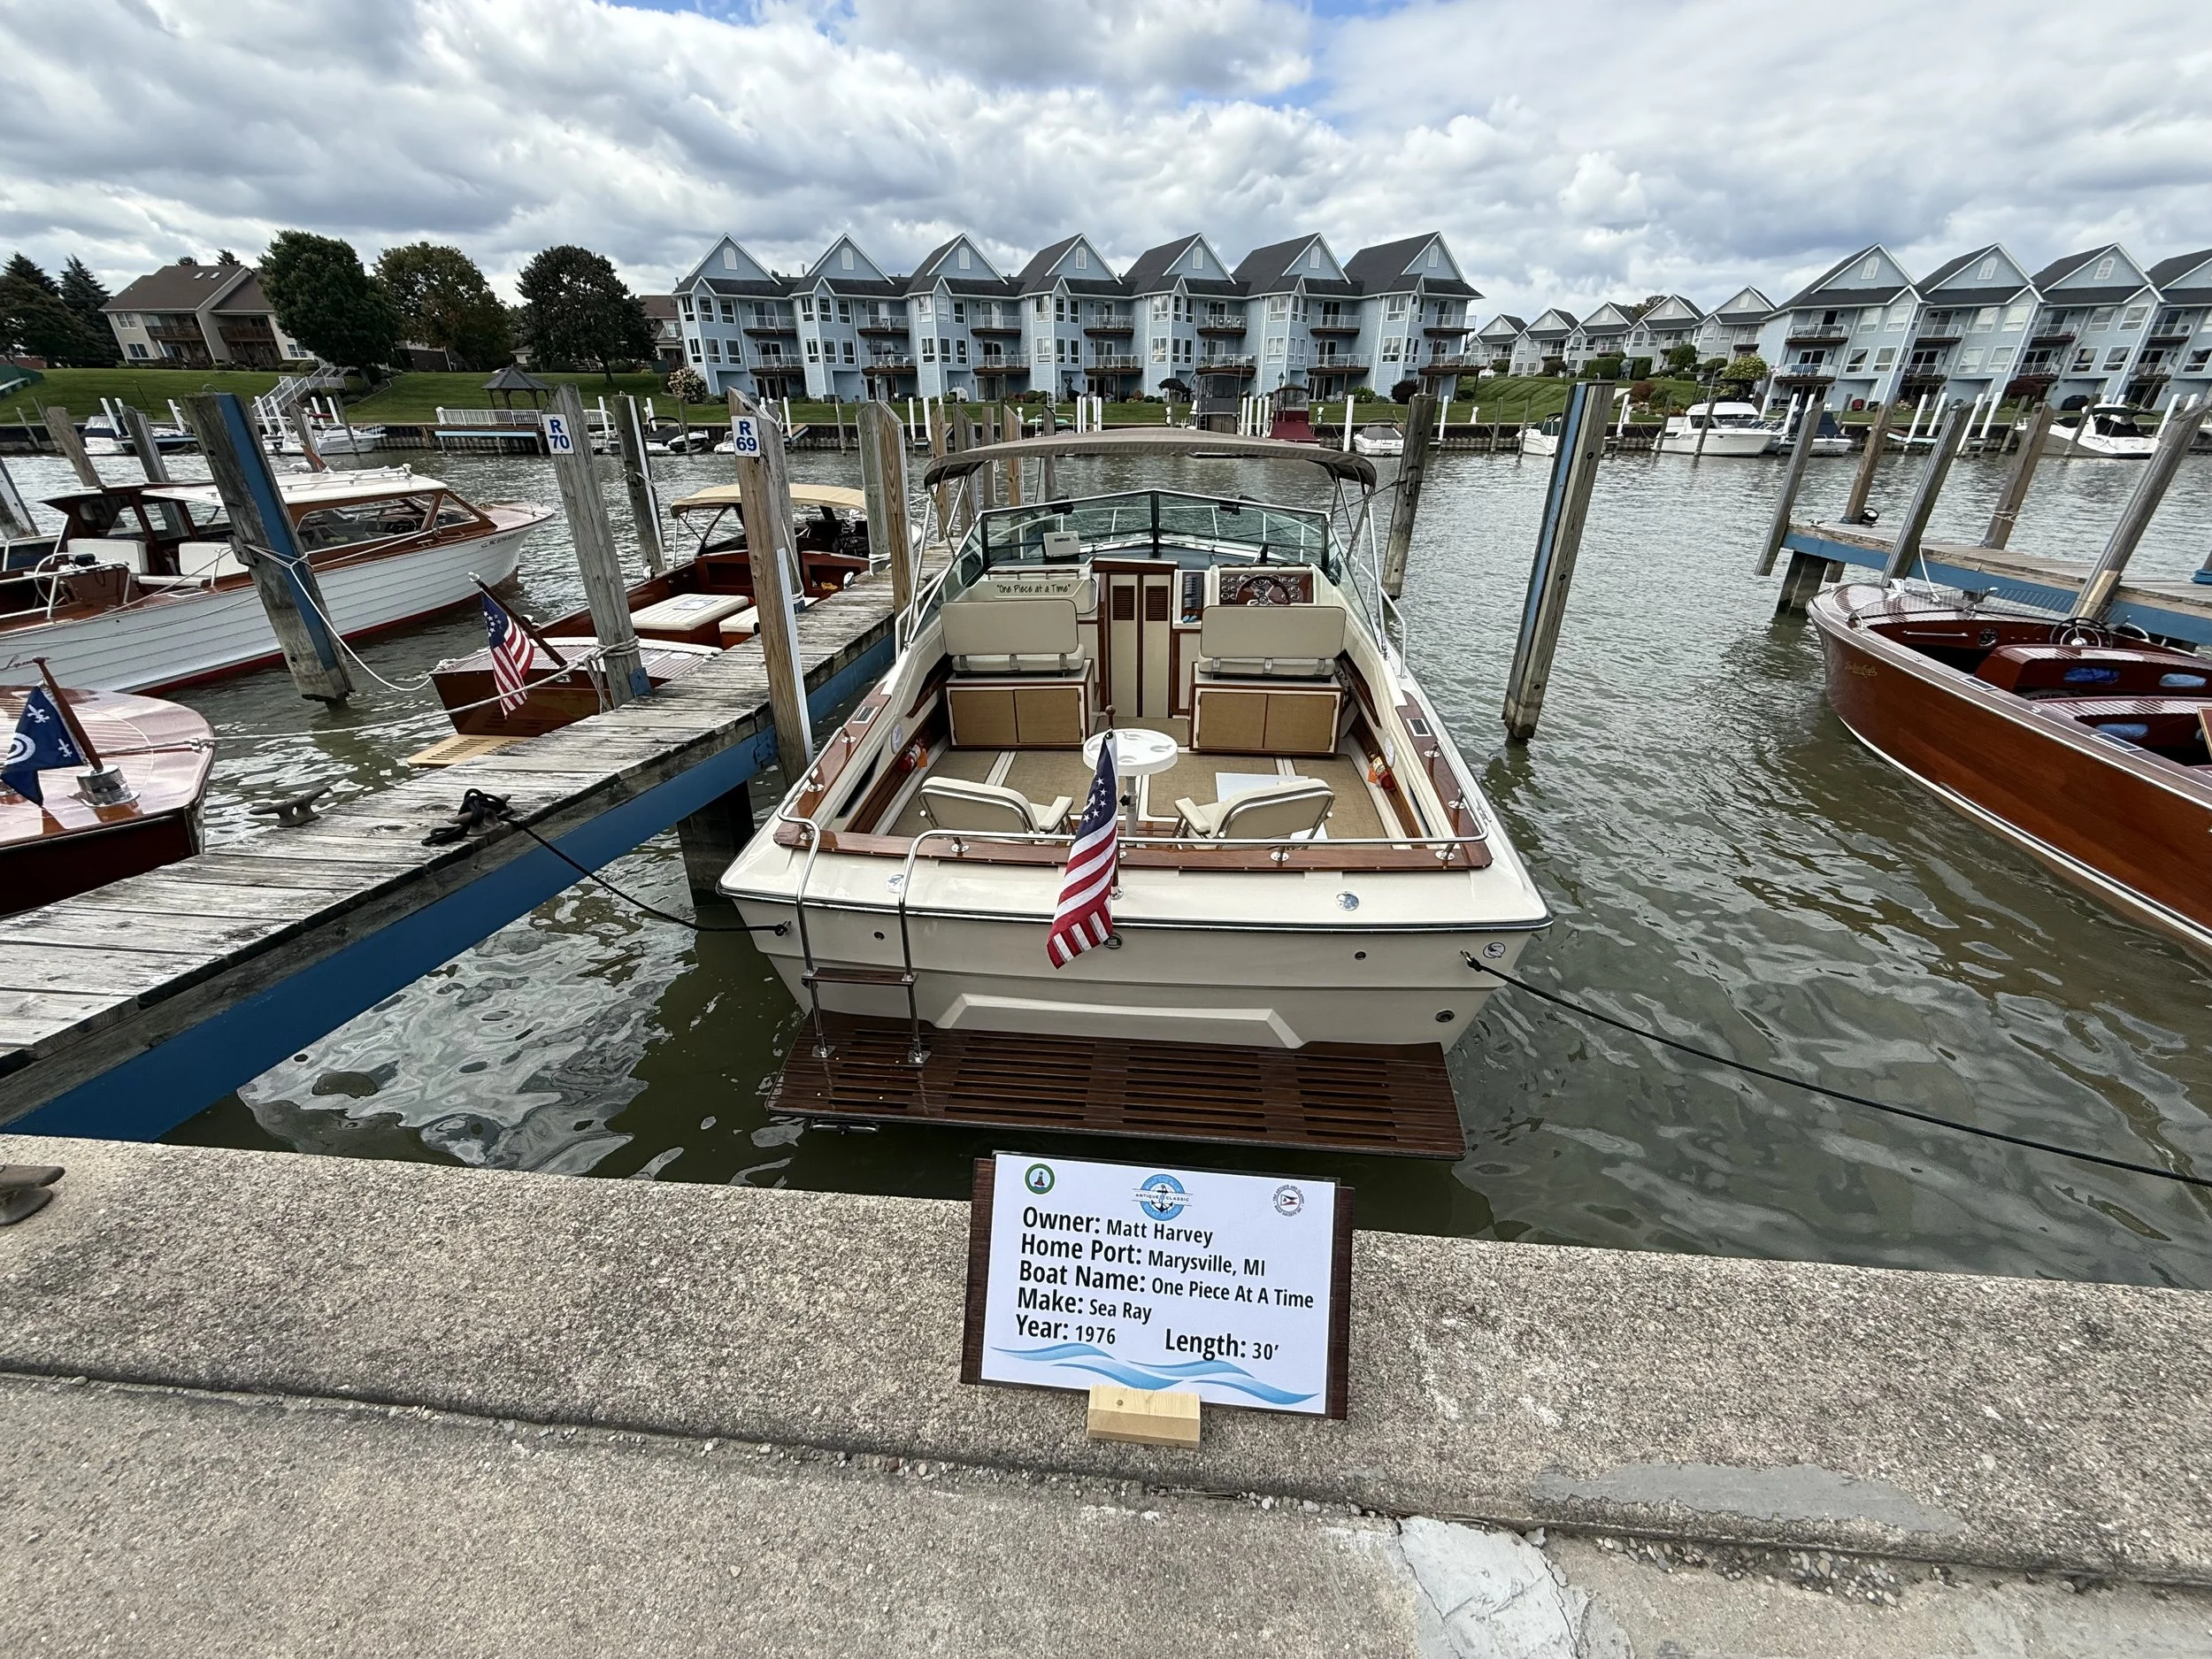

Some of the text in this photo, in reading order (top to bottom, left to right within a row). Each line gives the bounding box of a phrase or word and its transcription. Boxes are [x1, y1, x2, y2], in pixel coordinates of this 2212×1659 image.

[549, 419, 564, 434] R
[739, 420, 752, 435] R
[549, 434, 570, 449] 70
[736, 436, 757, 452] 69
[1013, 584, 1033, 594] Piece
[1023, 1206, 1213, 1249] Owner: Matt Harvey
[1021, 1233, 1265, 1277] Home Port: Marysville, MI
[1019, 1260, 1314, 1309] Boat Name: One Piece At A Time
[1017, 1286, 1152, 1325] Make: Sea Ray
[1016, 1313, 1279, 1361] Year: 1976 Length: 30'
